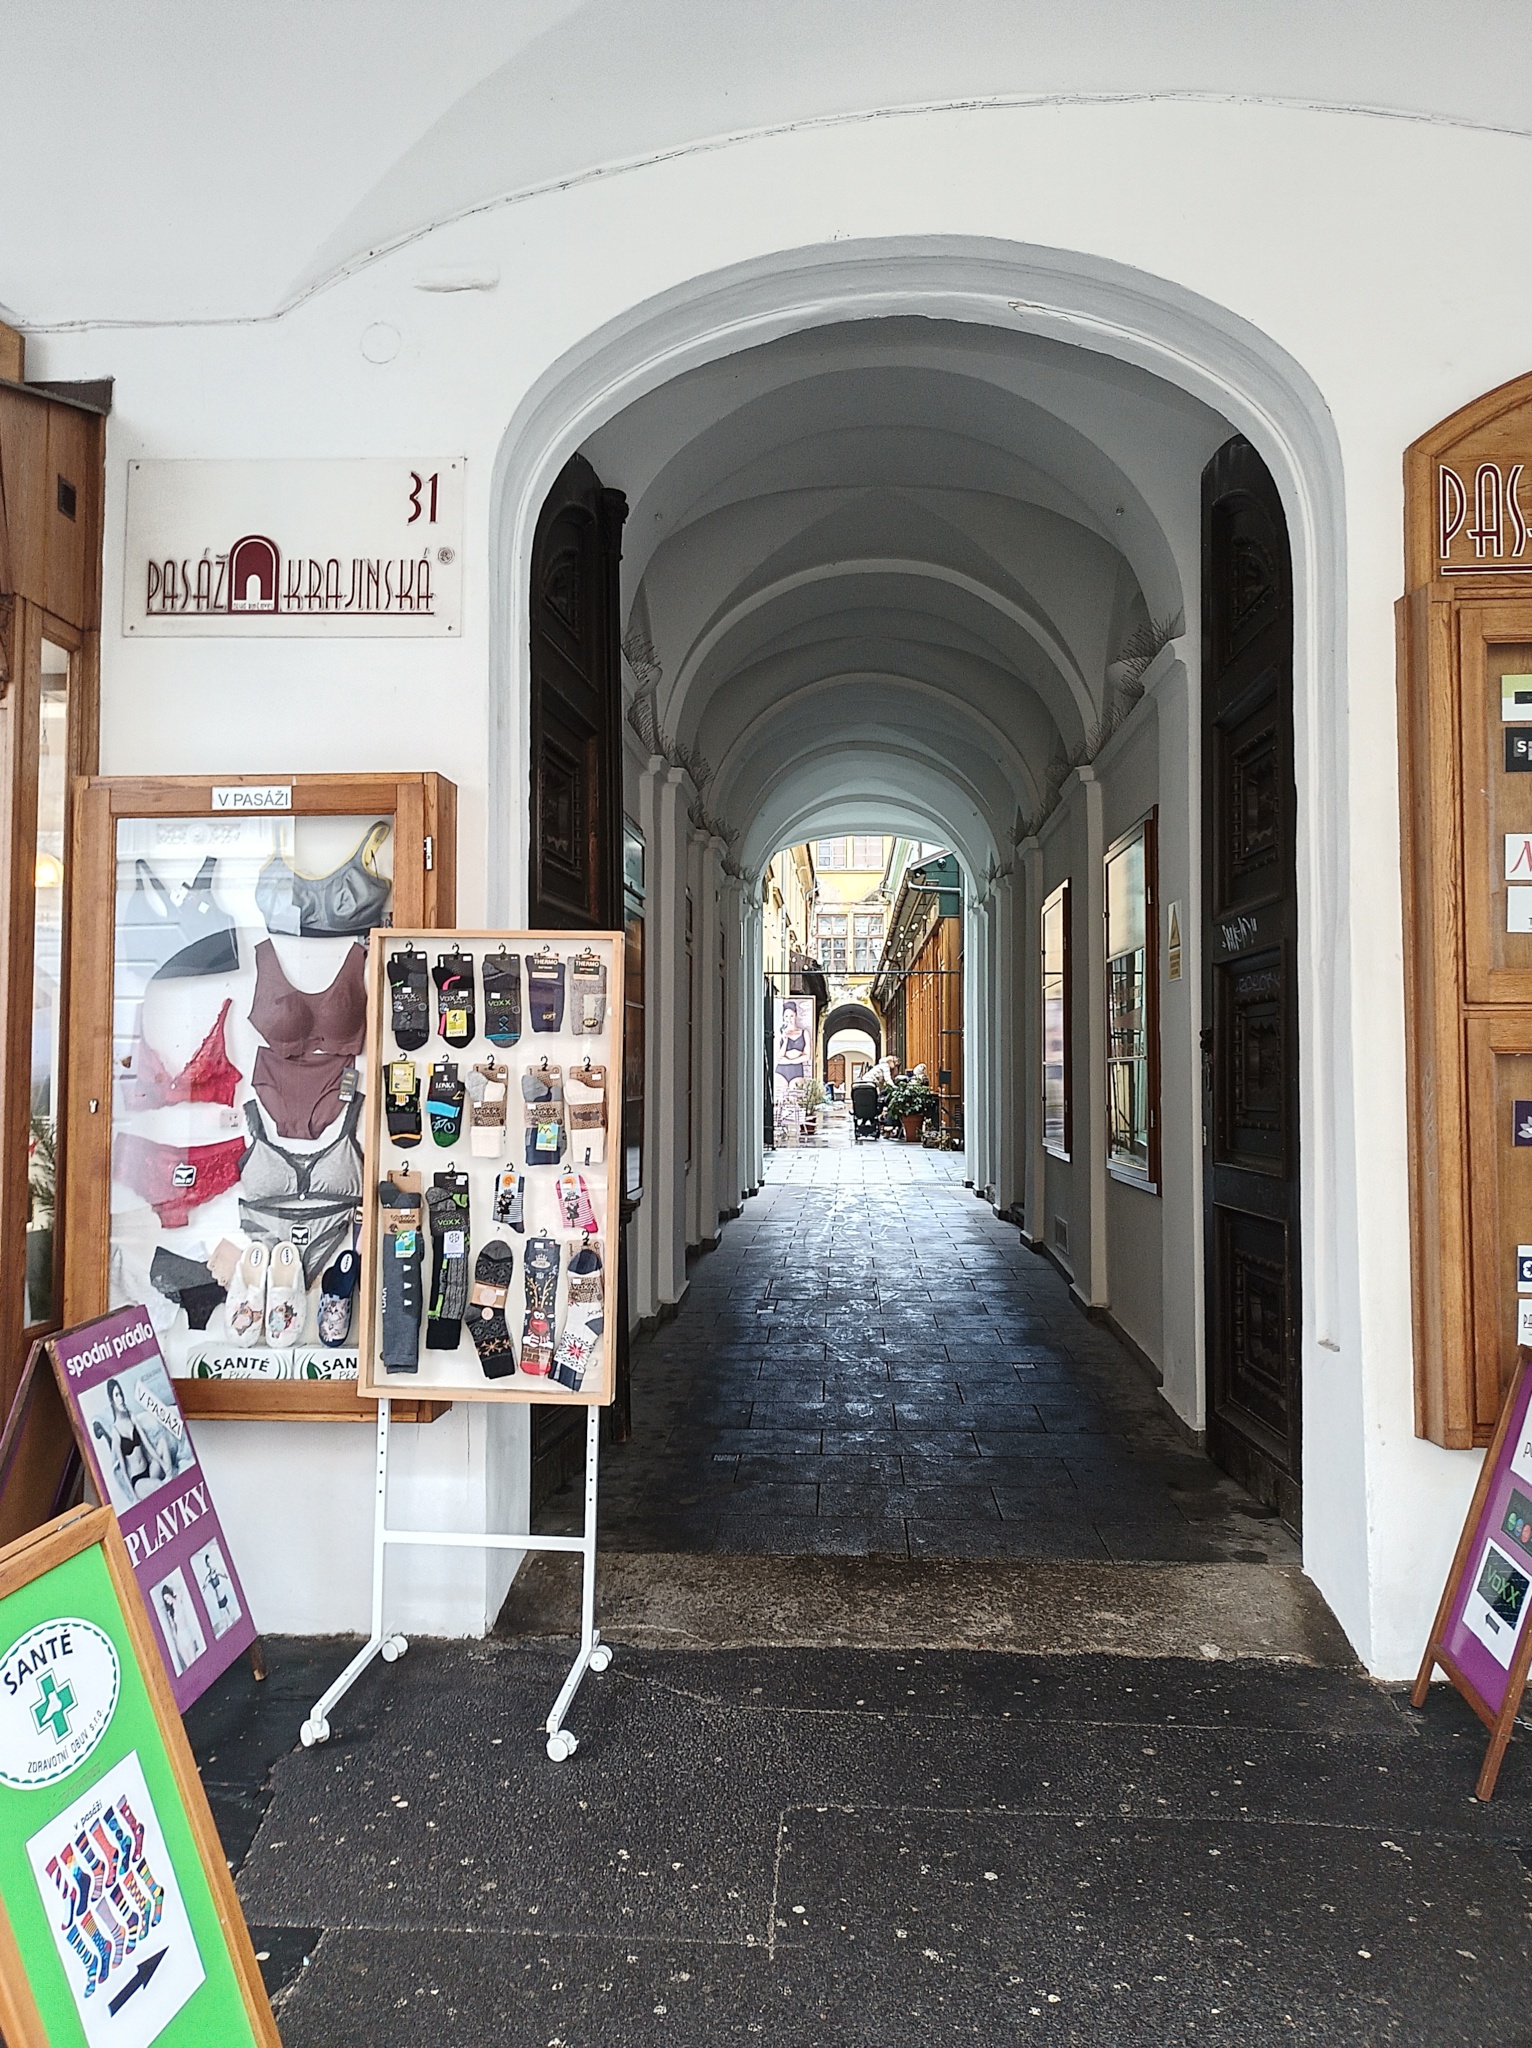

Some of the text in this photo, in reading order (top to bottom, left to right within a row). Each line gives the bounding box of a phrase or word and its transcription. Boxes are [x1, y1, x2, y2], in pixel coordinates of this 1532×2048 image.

[408, 471, 438, 523] 31
[147, 547, 435, 611] PASÁŽ KRAJINSKÁ
[218, 790, 288, 806] V PASÁŽI
[66, 1322, 153, 1378] spodní prádlo
[213, 1357, 270, 1372] SANTÉ
[124, 1482, 210, 1569] PLAVKY
[4, 1629, 73, 1696] SANTÉ
[28, 1708, 104, 1774] ZDRAVOTNÍ OBUV s.r.o.
